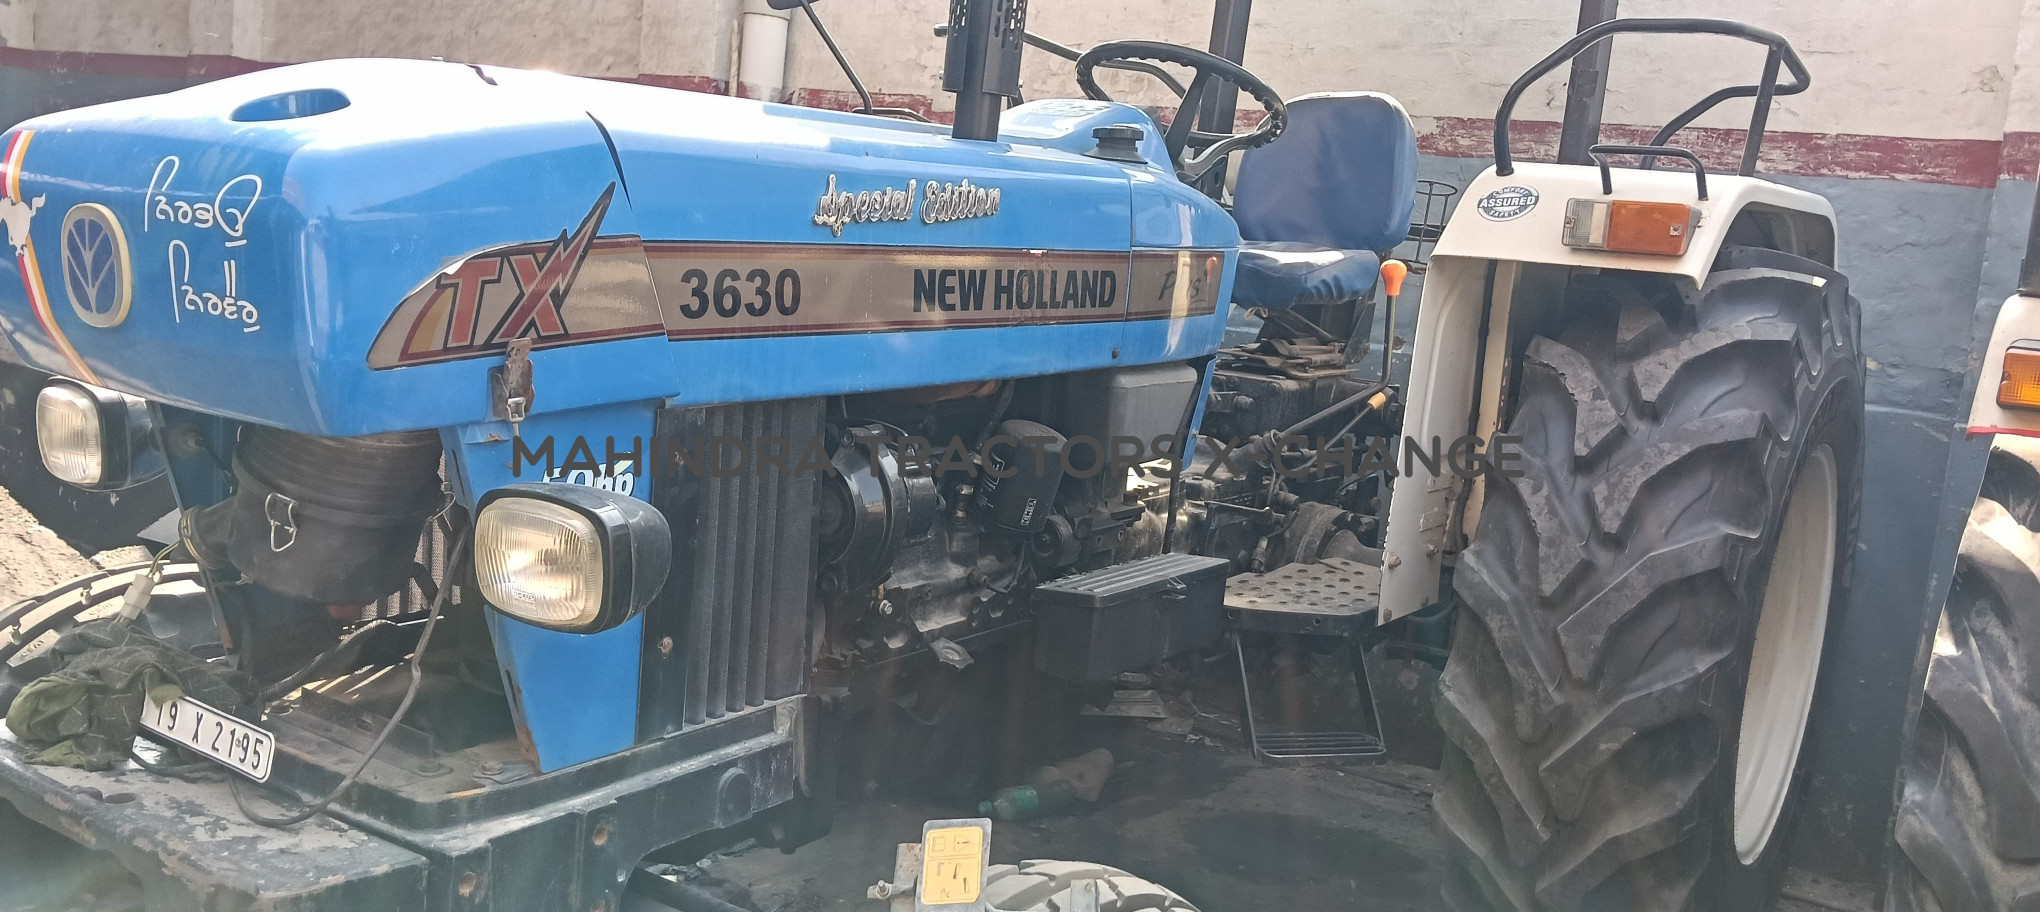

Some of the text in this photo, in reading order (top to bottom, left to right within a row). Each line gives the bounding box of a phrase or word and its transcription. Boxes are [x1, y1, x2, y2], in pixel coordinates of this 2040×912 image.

[813, 173, 1001, 237] Special Edition
[1479, 196, 1536, 208] ASSURED
[1488, 208, 1520, 218] SAFETY
[434, 181, 616, 351] TX
[912, 269, 1117, 312] NEW HOLLAND
[679, 268, 801, 319] 3630
[192, 711, 204, 744] X
[211, 721, 264, 770] 2195
